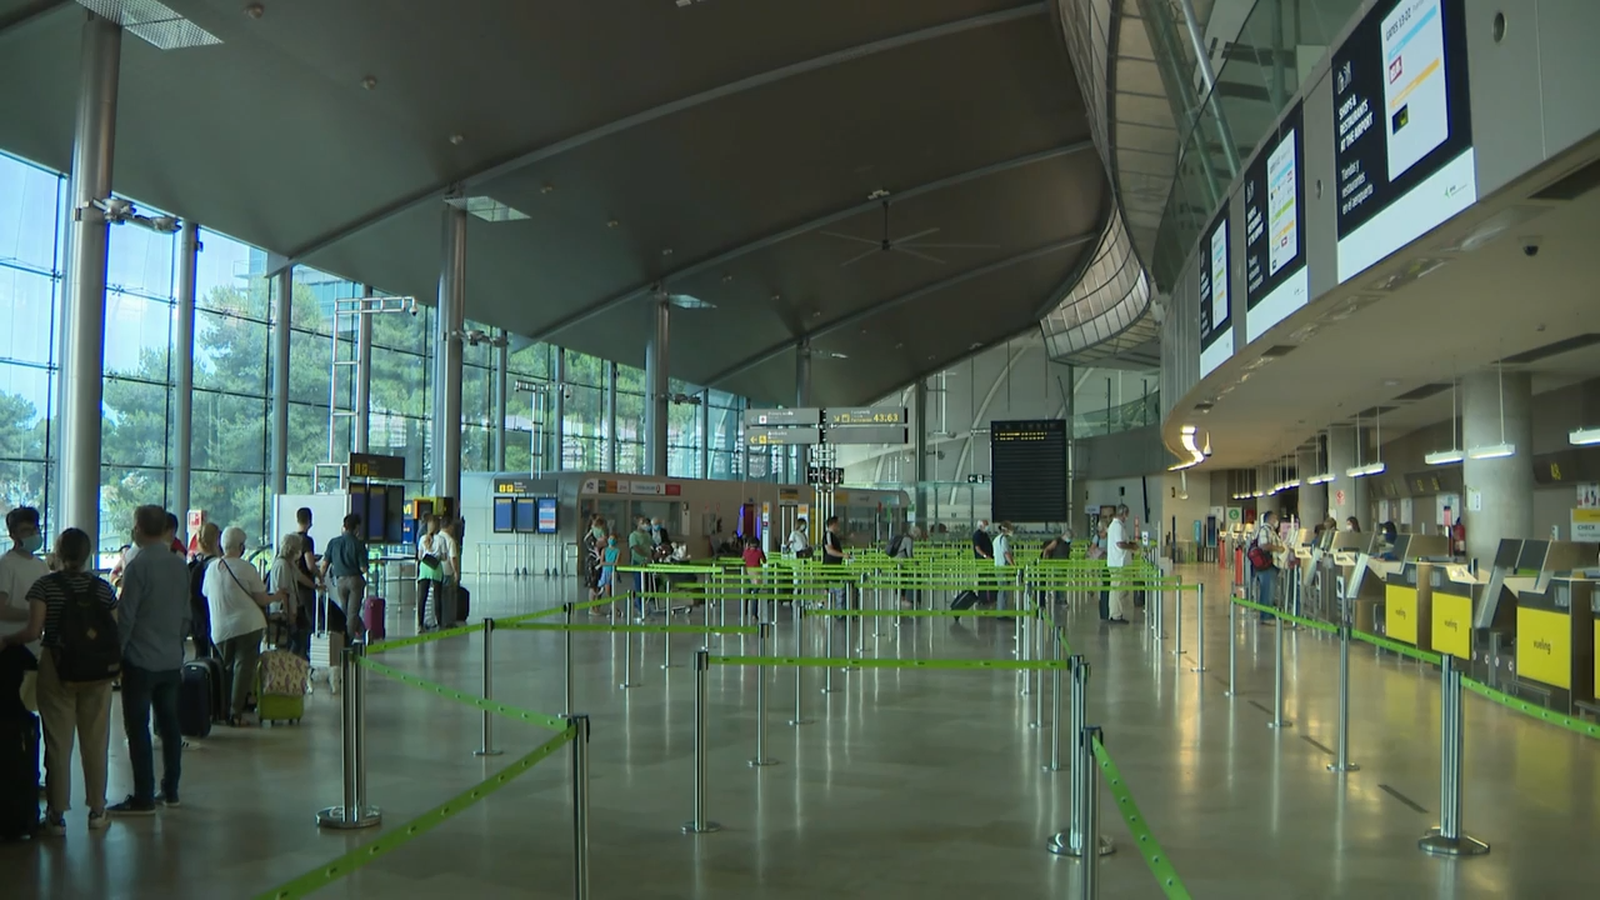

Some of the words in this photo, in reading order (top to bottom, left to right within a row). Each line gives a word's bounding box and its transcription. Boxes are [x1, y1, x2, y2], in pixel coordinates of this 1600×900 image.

[1339, 97, 1353, 120] SHOPS
[1339, 98, 1369, 136] RESTAURANTS
[1355, 112, 1373, 139] AIRPORT
[1533, 637, 1551, 655] vueling
